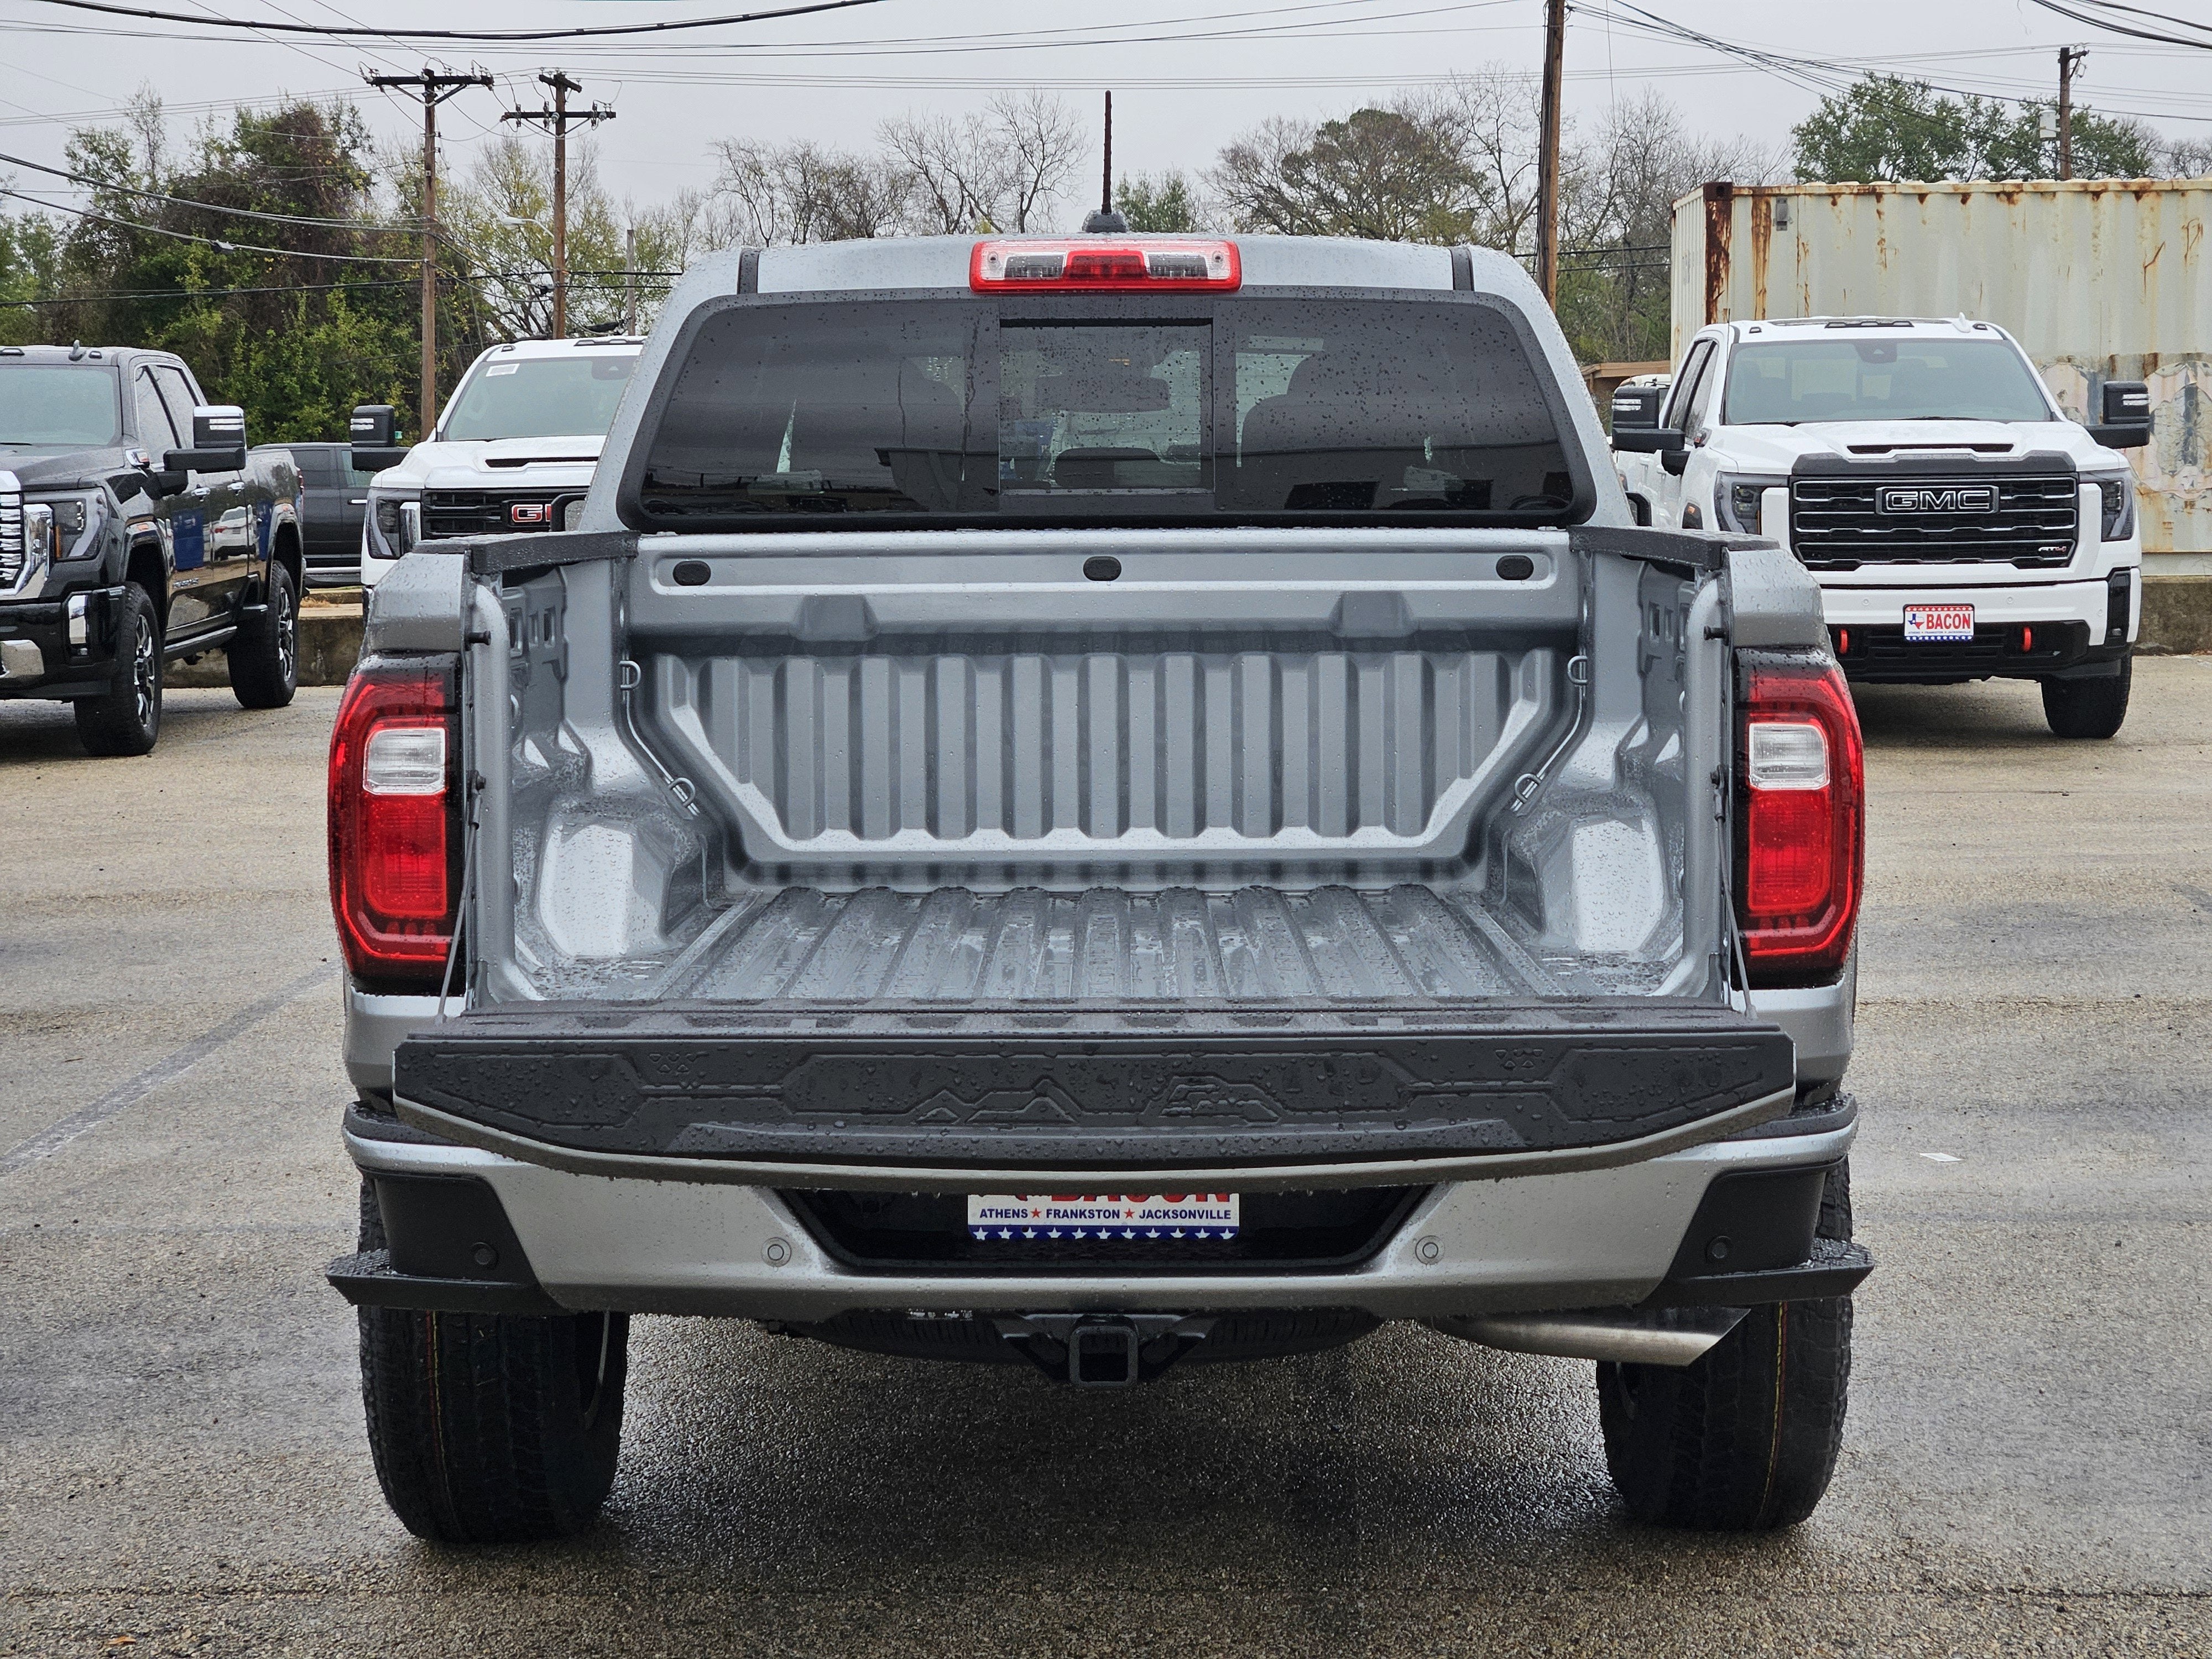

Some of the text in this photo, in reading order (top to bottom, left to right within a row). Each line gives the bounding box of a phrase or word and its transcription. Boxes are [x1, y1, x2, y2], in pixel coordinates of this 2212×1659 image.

[1886, 490, 1990, 510] GMC
[511, 504, 552, 523] G
[1926, 613, 1971, 629] BACON
[979, 1208, 1232, 1219] ATHENS FRANKSTON JACKSONVILLE
